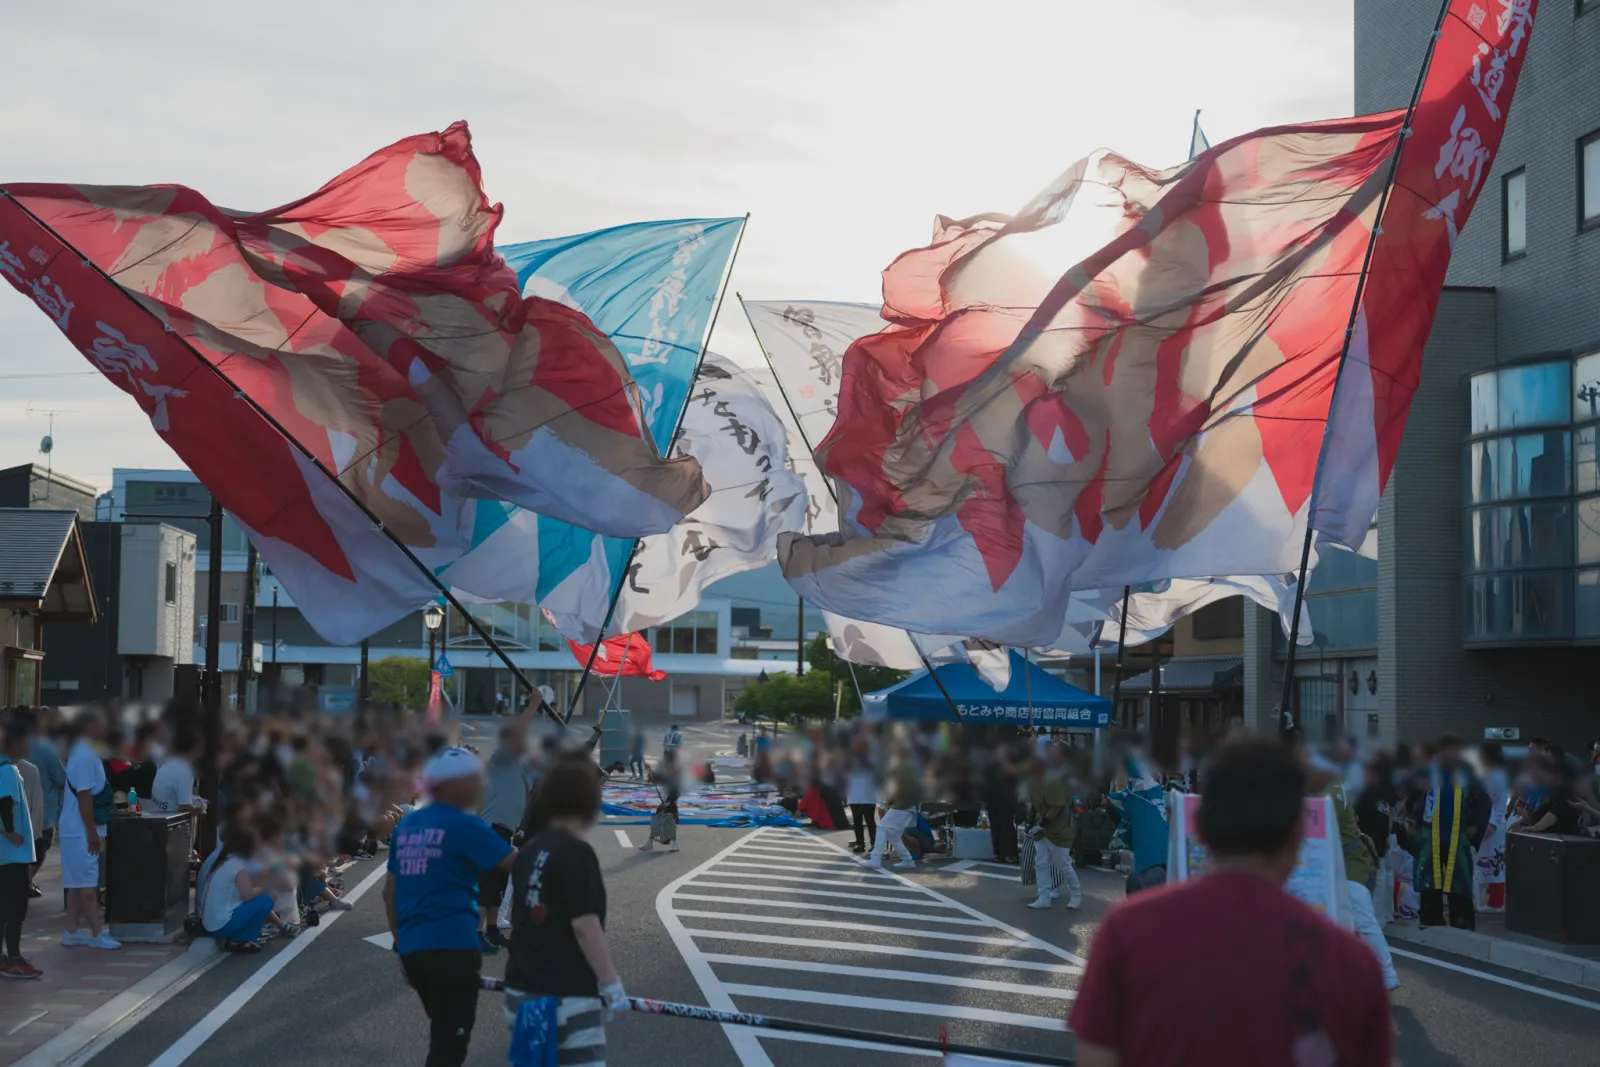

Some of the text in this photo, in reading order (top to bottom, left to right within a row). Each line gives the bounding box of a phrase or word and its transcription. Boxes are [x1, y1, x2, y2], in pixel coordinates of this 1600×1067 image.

[956, 703, 1092, 721] もとみや商店街協同組合
